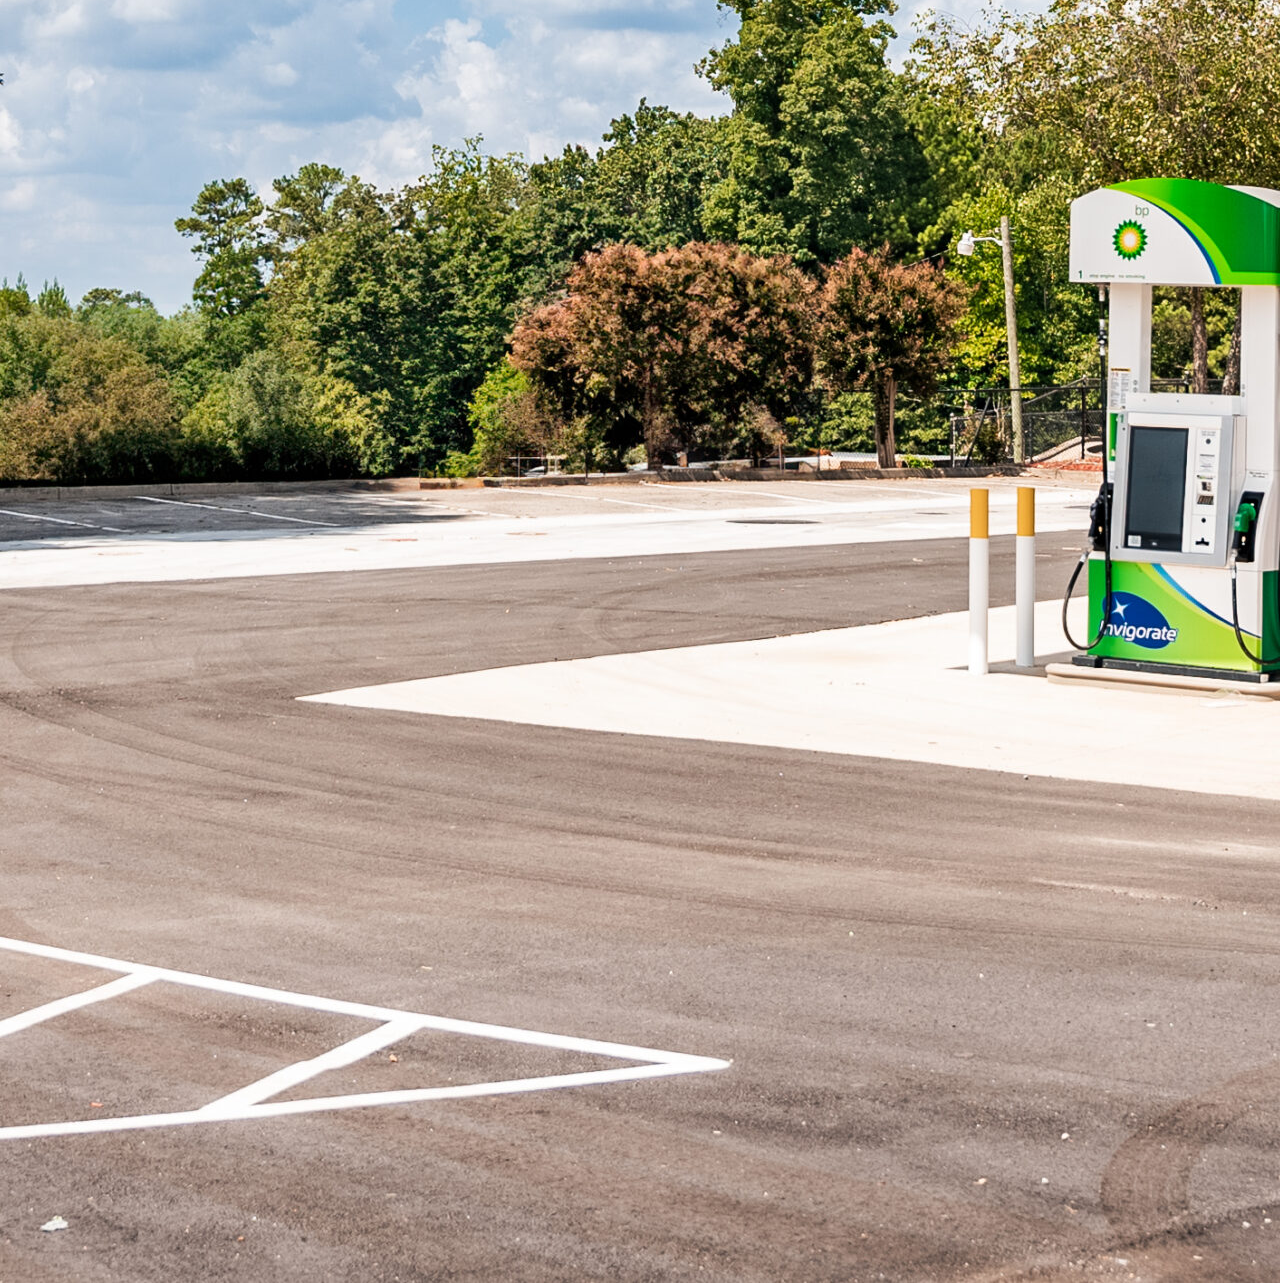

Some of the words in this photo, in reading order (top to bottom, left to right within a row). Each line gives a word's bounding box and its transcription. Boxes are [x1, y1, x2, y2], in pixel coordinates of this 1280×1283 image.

[1135, 204, 1150, 219] bp
[1078, 270, 1083, 279] 1
[1100, 620, 1177, 642] Invigorate
